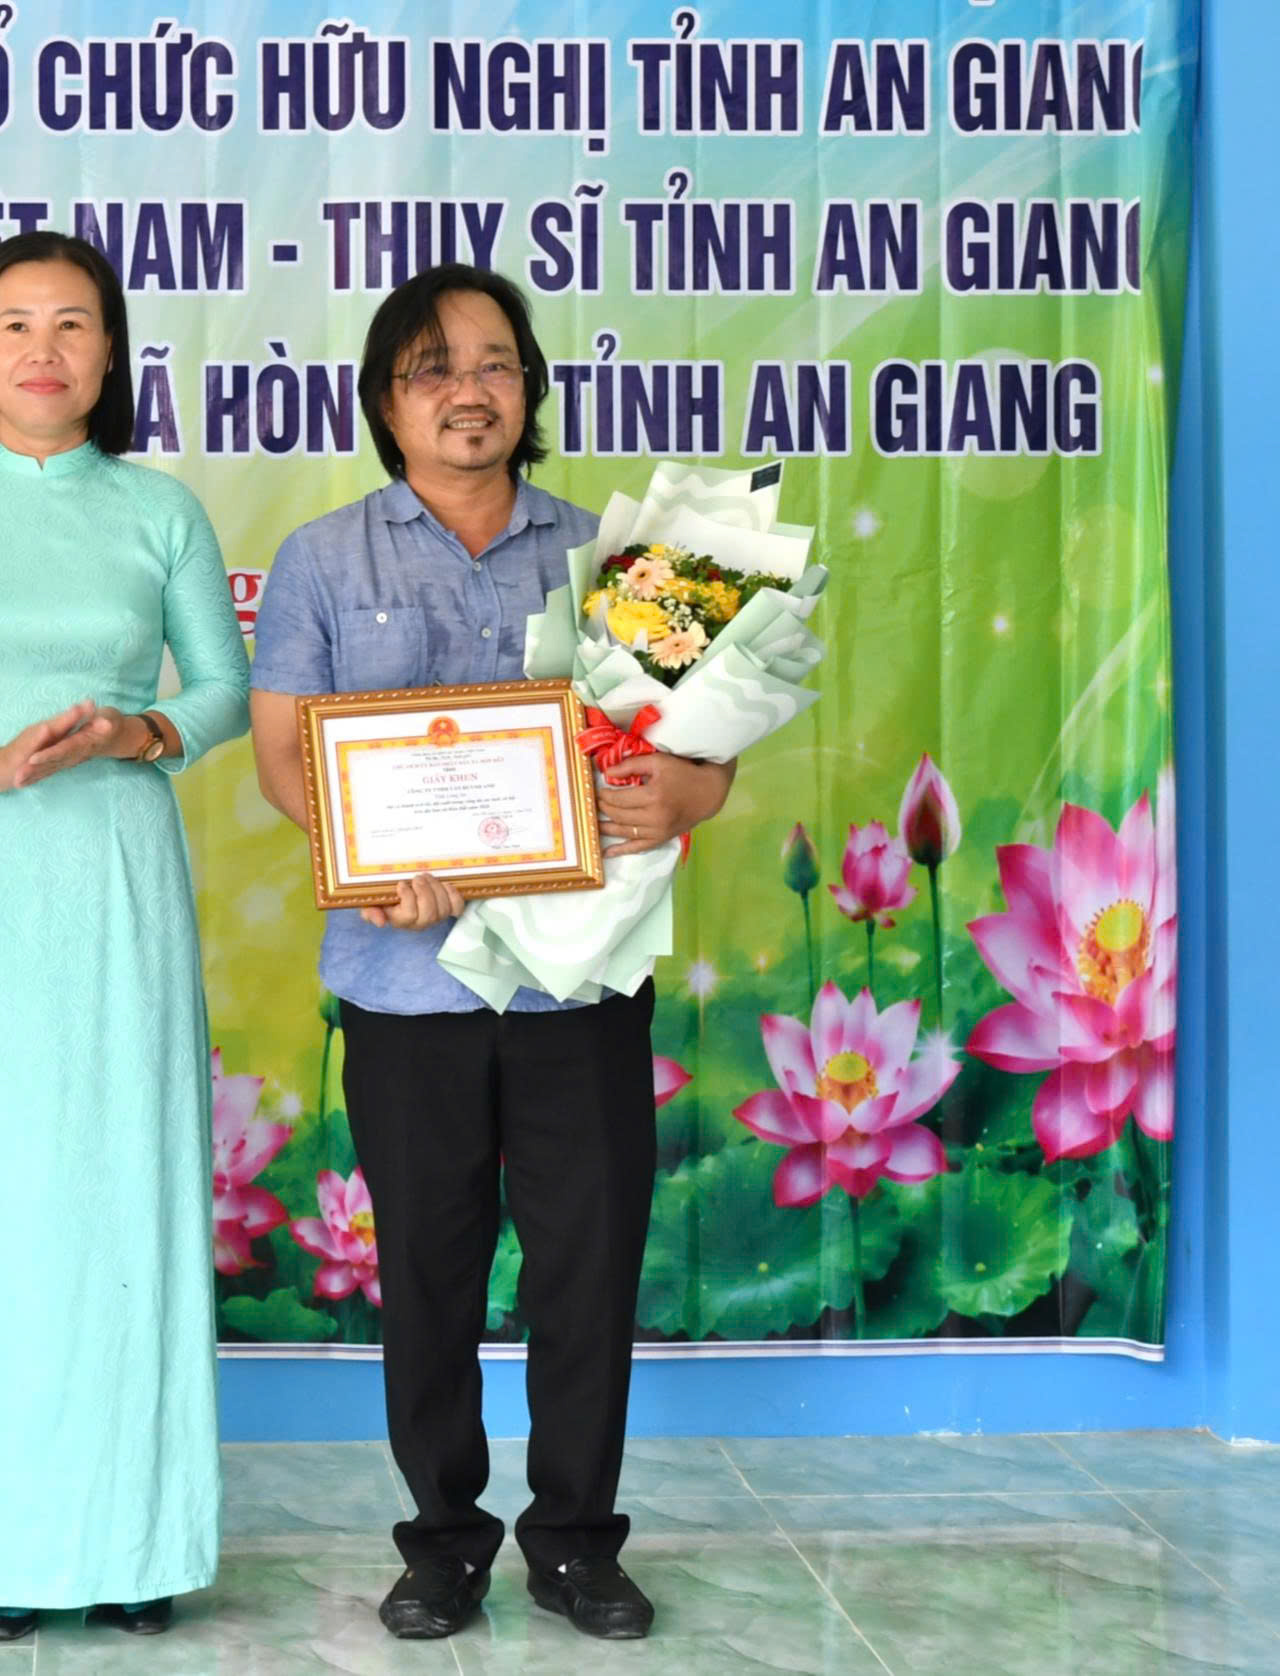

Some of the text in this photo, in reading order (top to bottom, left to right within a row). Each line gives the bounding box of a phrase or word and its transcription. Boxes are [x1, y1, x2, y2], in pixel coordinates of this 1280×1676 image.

[38, 22, 233, 131] CHỨC
[262, 23, 406, 131] HỮU
[433, 42, 606, 152] NGHỊ
[632, 11, 798, 131] TỈNH
[823, 44, 925, 131] AN
[953, 42, 1143, 132] GIAN
[74, 202, 244, 290] NAM
[530, 184, 604, 291] SĨ
[625, 171, 791, 291] TỈNH
[816, 203, 918, 291] AN
[206, 342, 354, 454] HÒN
[553, 333, 719, 453] TỈNH
[745, 365, 847, 453] AN
[874, 363, 1097, 453] GIANG
